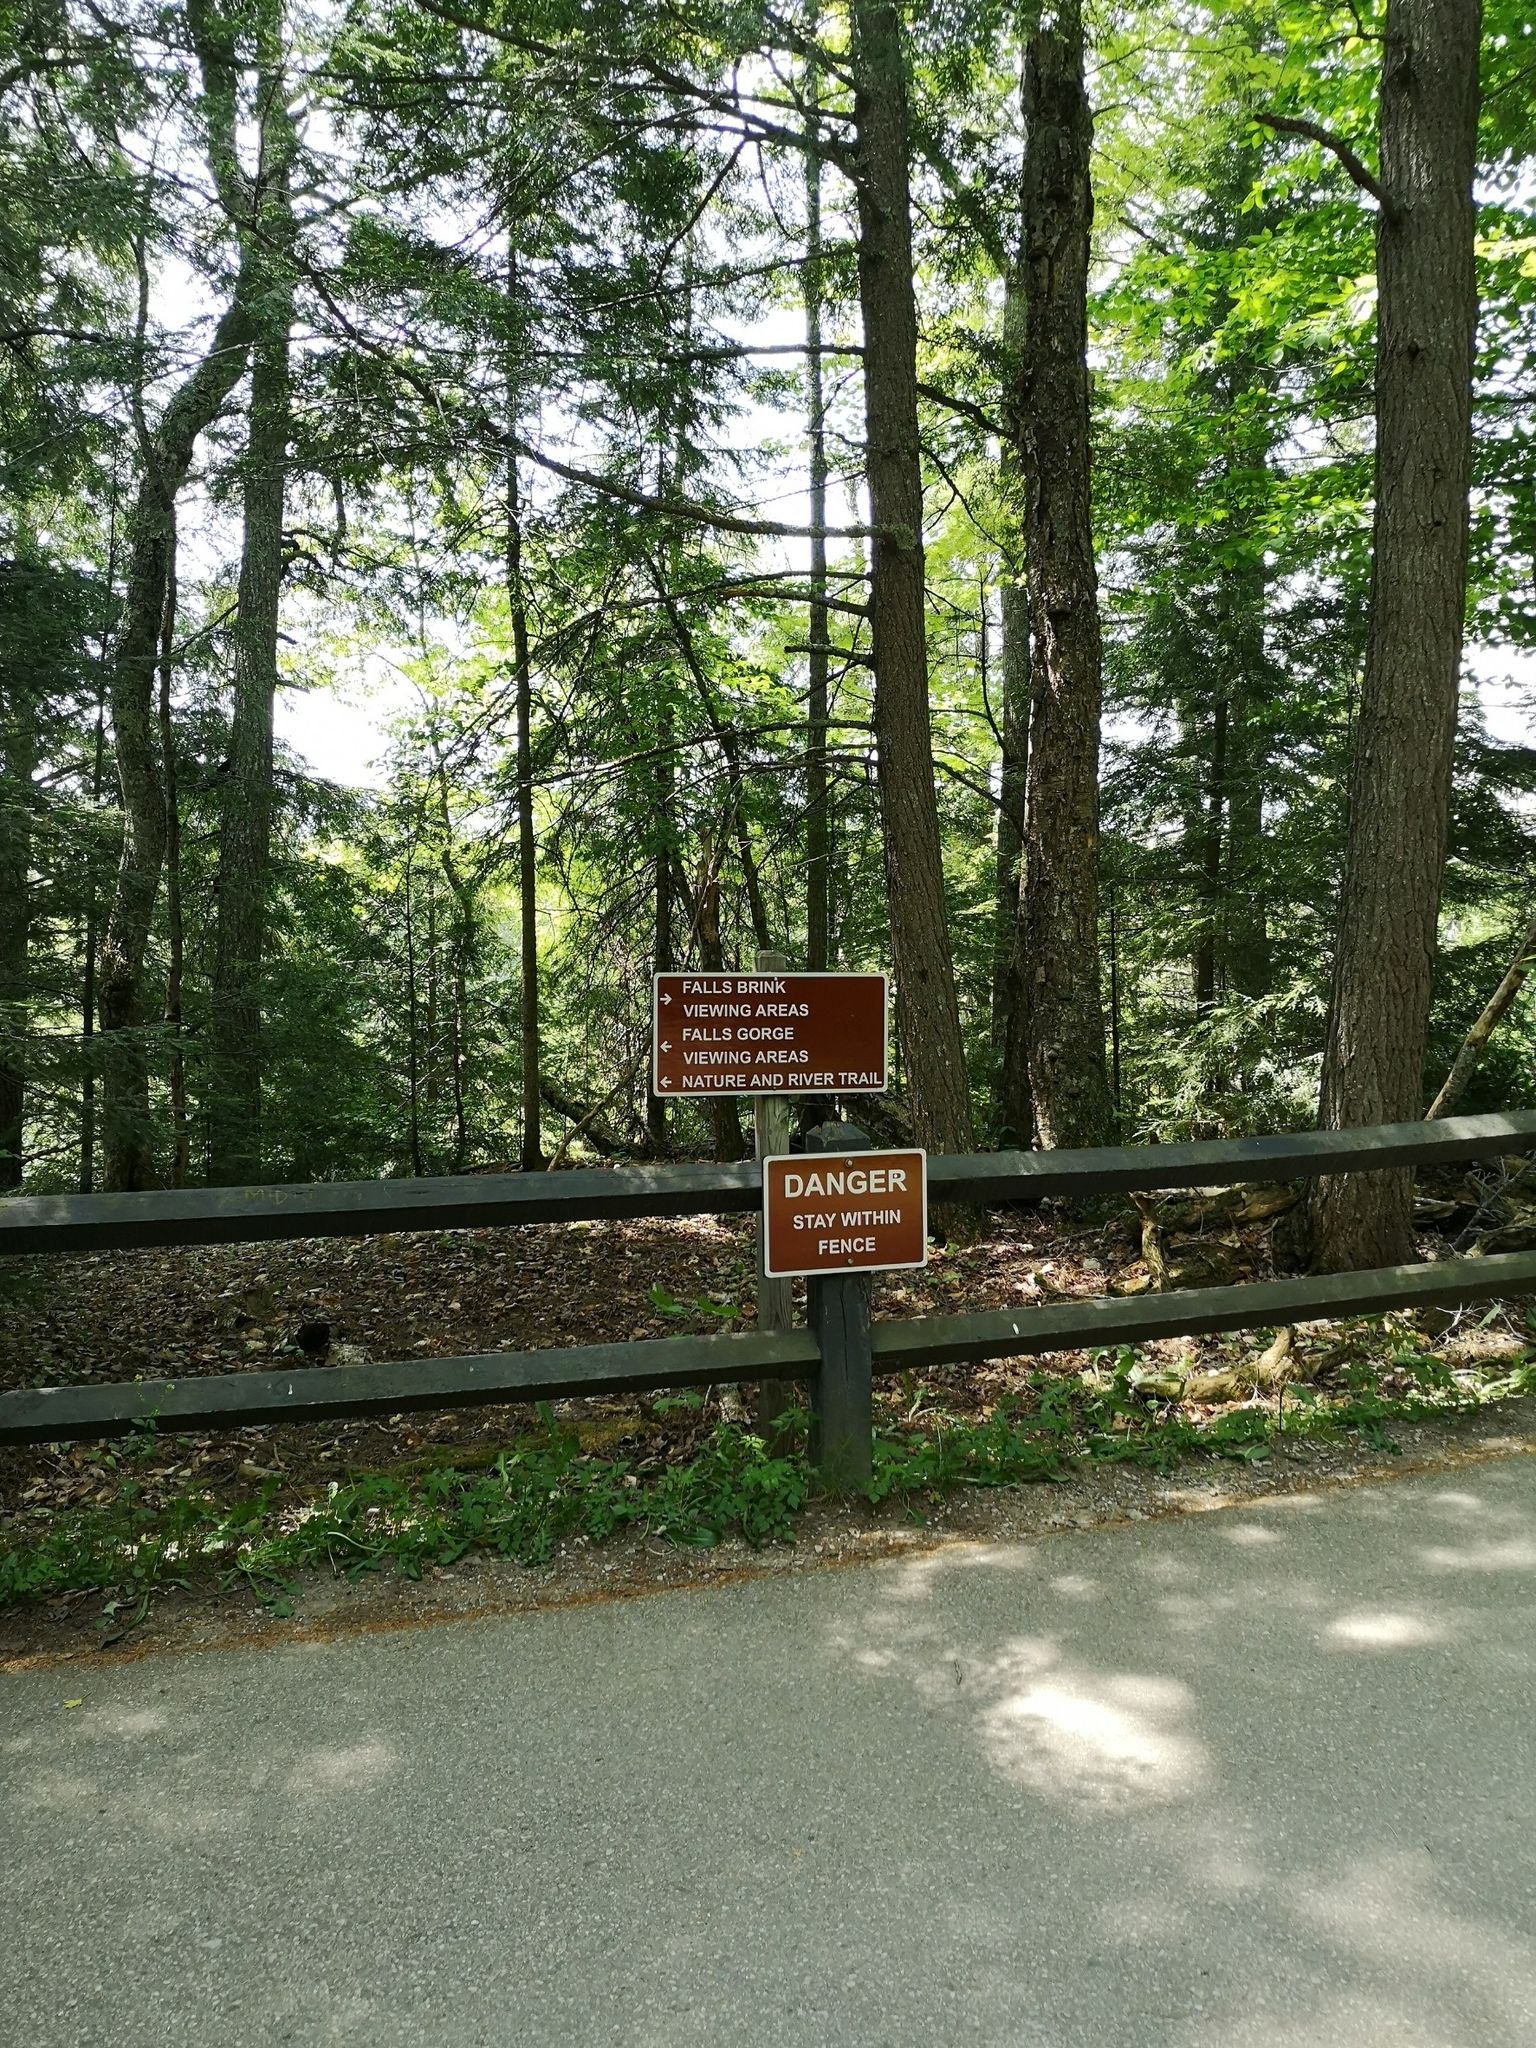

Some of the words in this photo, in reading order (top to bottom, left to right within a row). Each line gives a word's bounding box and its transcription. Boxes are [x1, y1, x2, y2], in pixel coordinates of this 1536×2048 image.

[682, 981, 733, 994] FALLS
[737, 980, 786, 994] BRINK
[683, 1004, 752, 1018] VIEWING
[754, 1003, 809, 1017] AREAS
[682, 1028, 733, 1041] FALLS
[736, 1027, 794, 1041] GORGE
[683, 1051, 752, 1065] VIEWING
[754, 1050, 809, 1064] AREAS
[682, 1074, 747, 1088] NATURE
[749, 1073, 784, 1087] AND
[788, 1072, 835, 1086] RIVER
[838, 1072, 883, 1085] TRAIL
[784, 1169, 907, 1198] DANGER
[793, 1212, 837, 1230] STAY
[840, 1209, 901, 1227] WITHIN
[818, 1236, 876, 1255] FENCE
